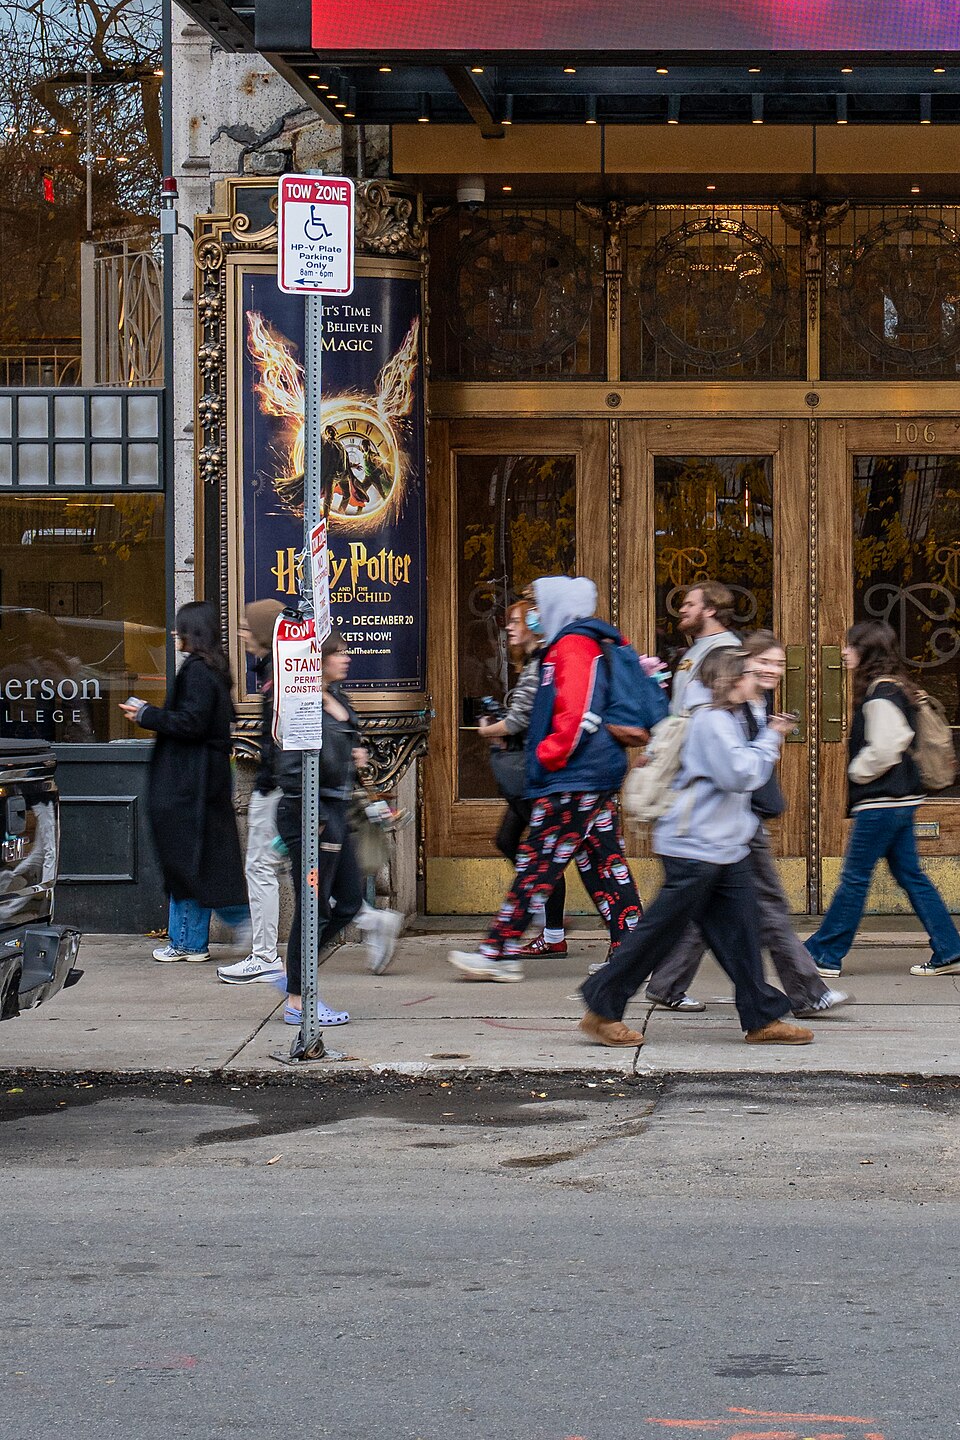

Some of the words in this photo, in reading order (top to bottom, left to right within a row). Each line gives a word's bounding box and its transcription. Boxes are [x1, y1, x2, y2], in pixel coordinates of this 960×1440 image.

[286, 183, 312, 199] TOW
[315, 185, 347, 202] ZONE
[291, 243, 315, 252] HP-V
[318, 245, 342, 253] Plate
[299, 252, 334, 262] Parking
[306, 261, 327, 270] Only
[299, 268, 314, 277] 8am
[319, 269, 334, 278] 6pm
[894, 422, 936, 443] 106
[348, 542, 412, 598] Potter
[330, 592, 353, 603] SED
[356, 592, 392, 603] CHILD
[336, 616, 343, 626] 9
[352, 615, 404, 626] DECEMBER
[404, 615, 414, 625] 20
[284, 621, 310, 638] TOW
[340, 632, 365, 642] KETS
[365, 631, 392, 641] NOW!
[284, 658, 322, 672] STAND
[0, 677, 103, 701] erson
[5, 710, 81, 723] LLEGE
